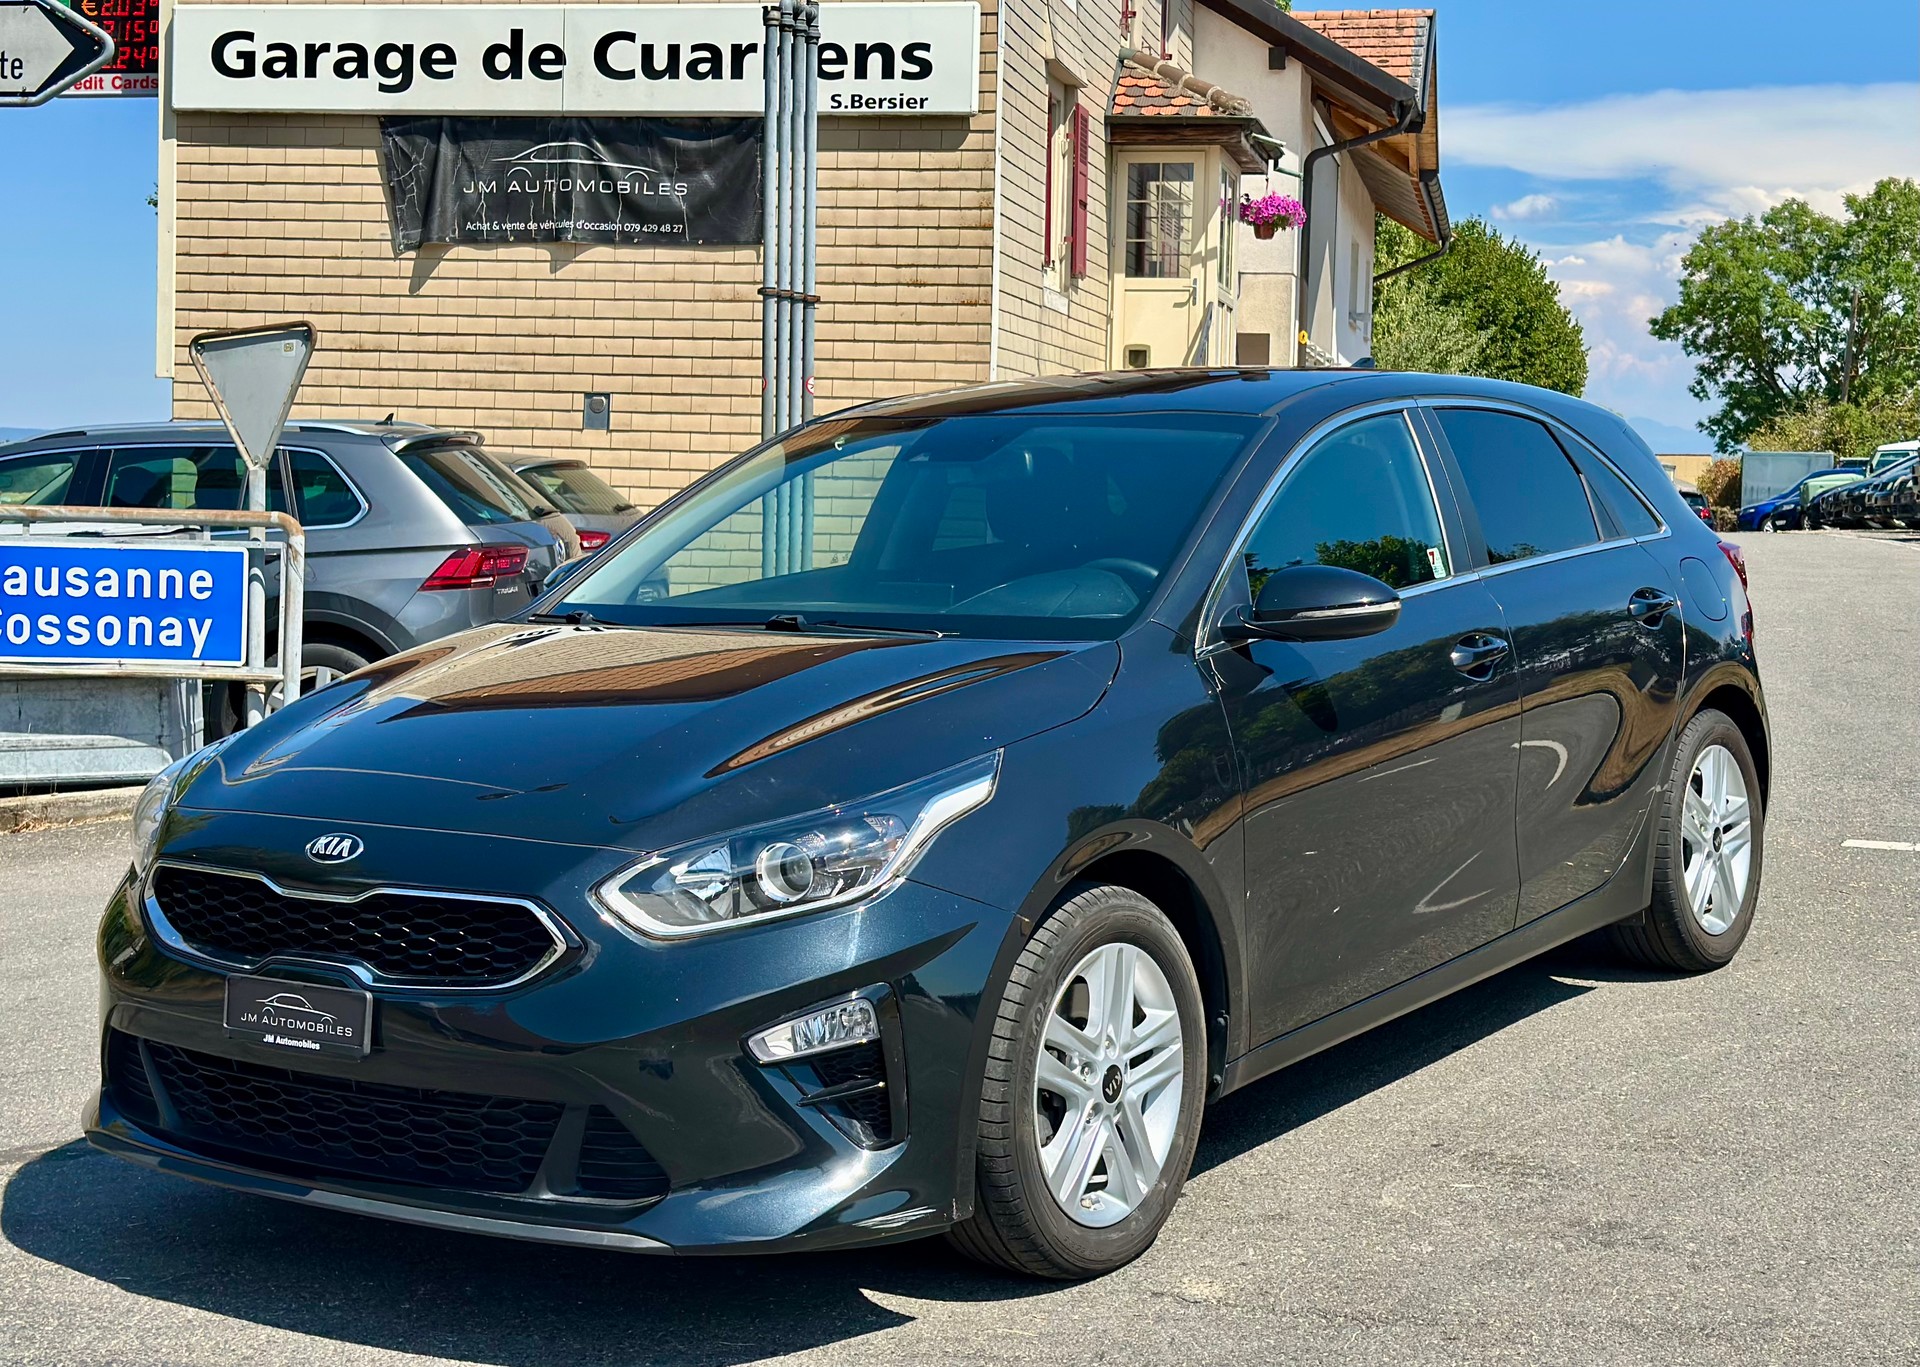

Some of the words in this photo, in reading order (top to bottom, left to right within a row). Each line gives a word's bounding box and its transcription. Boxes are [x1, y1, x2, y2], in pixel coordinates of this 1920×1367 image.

[210, 30, 457, 94] Garage
[482, 28, 567, 81] de
[593, 30, 933, 81] Cuarens
[72, 76, 104, 90] edit
[111, 75, 158, 90] Cards
[830, 92, 929, 110] S.Bersier
[462, 180, 497, 194] JM
[507, 178, 688, 196] AUTOMOBILES
[465, 221, 491, 231] Achat
[492, 221, 500, 231] &
[501, 222, 526, 231] vente
[526, 221, 538, 230] de
[576, 219, 622, 231] d'occasion
[623, 223, 641, 232] 079
[641, 224, 658, 233] 429
[659, 224, 671, 233] 48
[672, 224, 683, 233] 27
[3, 565, 214, 600] ausanne
[0, 609, 214, 659] ossonay
[311, 836, 353, 858] KIA
[240, 1012, 258, 1023] JM
[261, 1014, 354, 1038] AUTOMOBILES
[262, 1033, 275, 1044] JM
[275, 1035, 321, 1051] Automobiles
